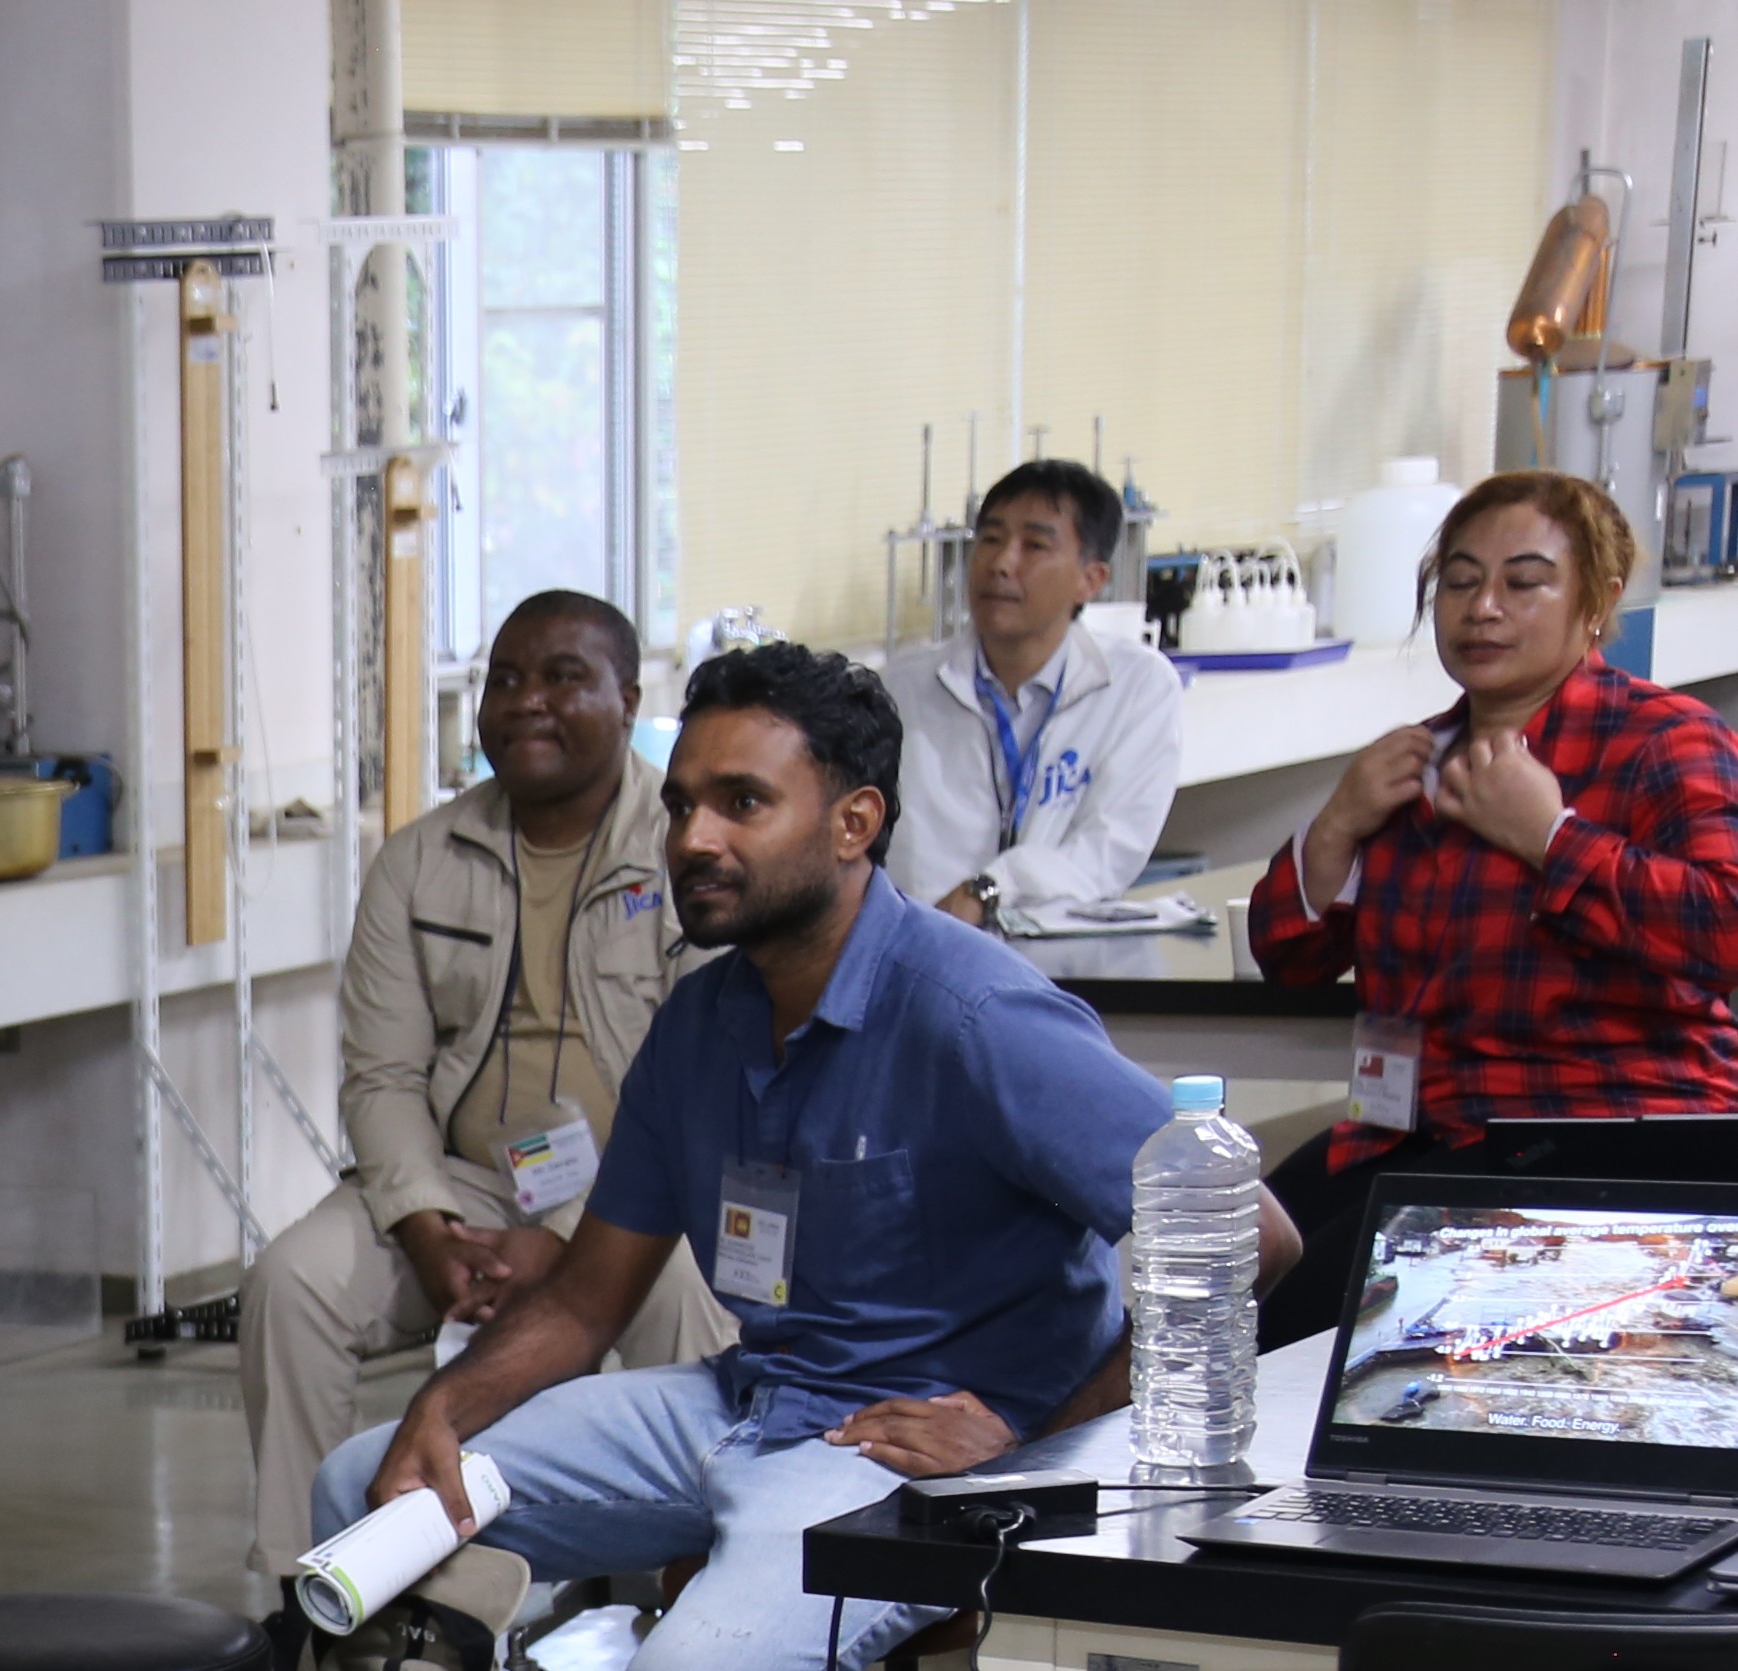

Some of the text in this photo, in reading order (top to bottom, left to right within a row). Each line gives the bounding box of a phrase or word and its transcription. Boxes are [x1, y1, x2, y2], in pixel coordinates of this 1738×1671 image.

[1439, 1228, 1494, 1240] Changes
[1496, 1226, 1509, 1238] in
[1510, 1225, 1552, 1240] global
[1553, 1226, 1610, 1238] average
[1612, 1224, 1704, 1236] temperature
[1488, 1413, 1621, 1434] Water. Food. Energy.
